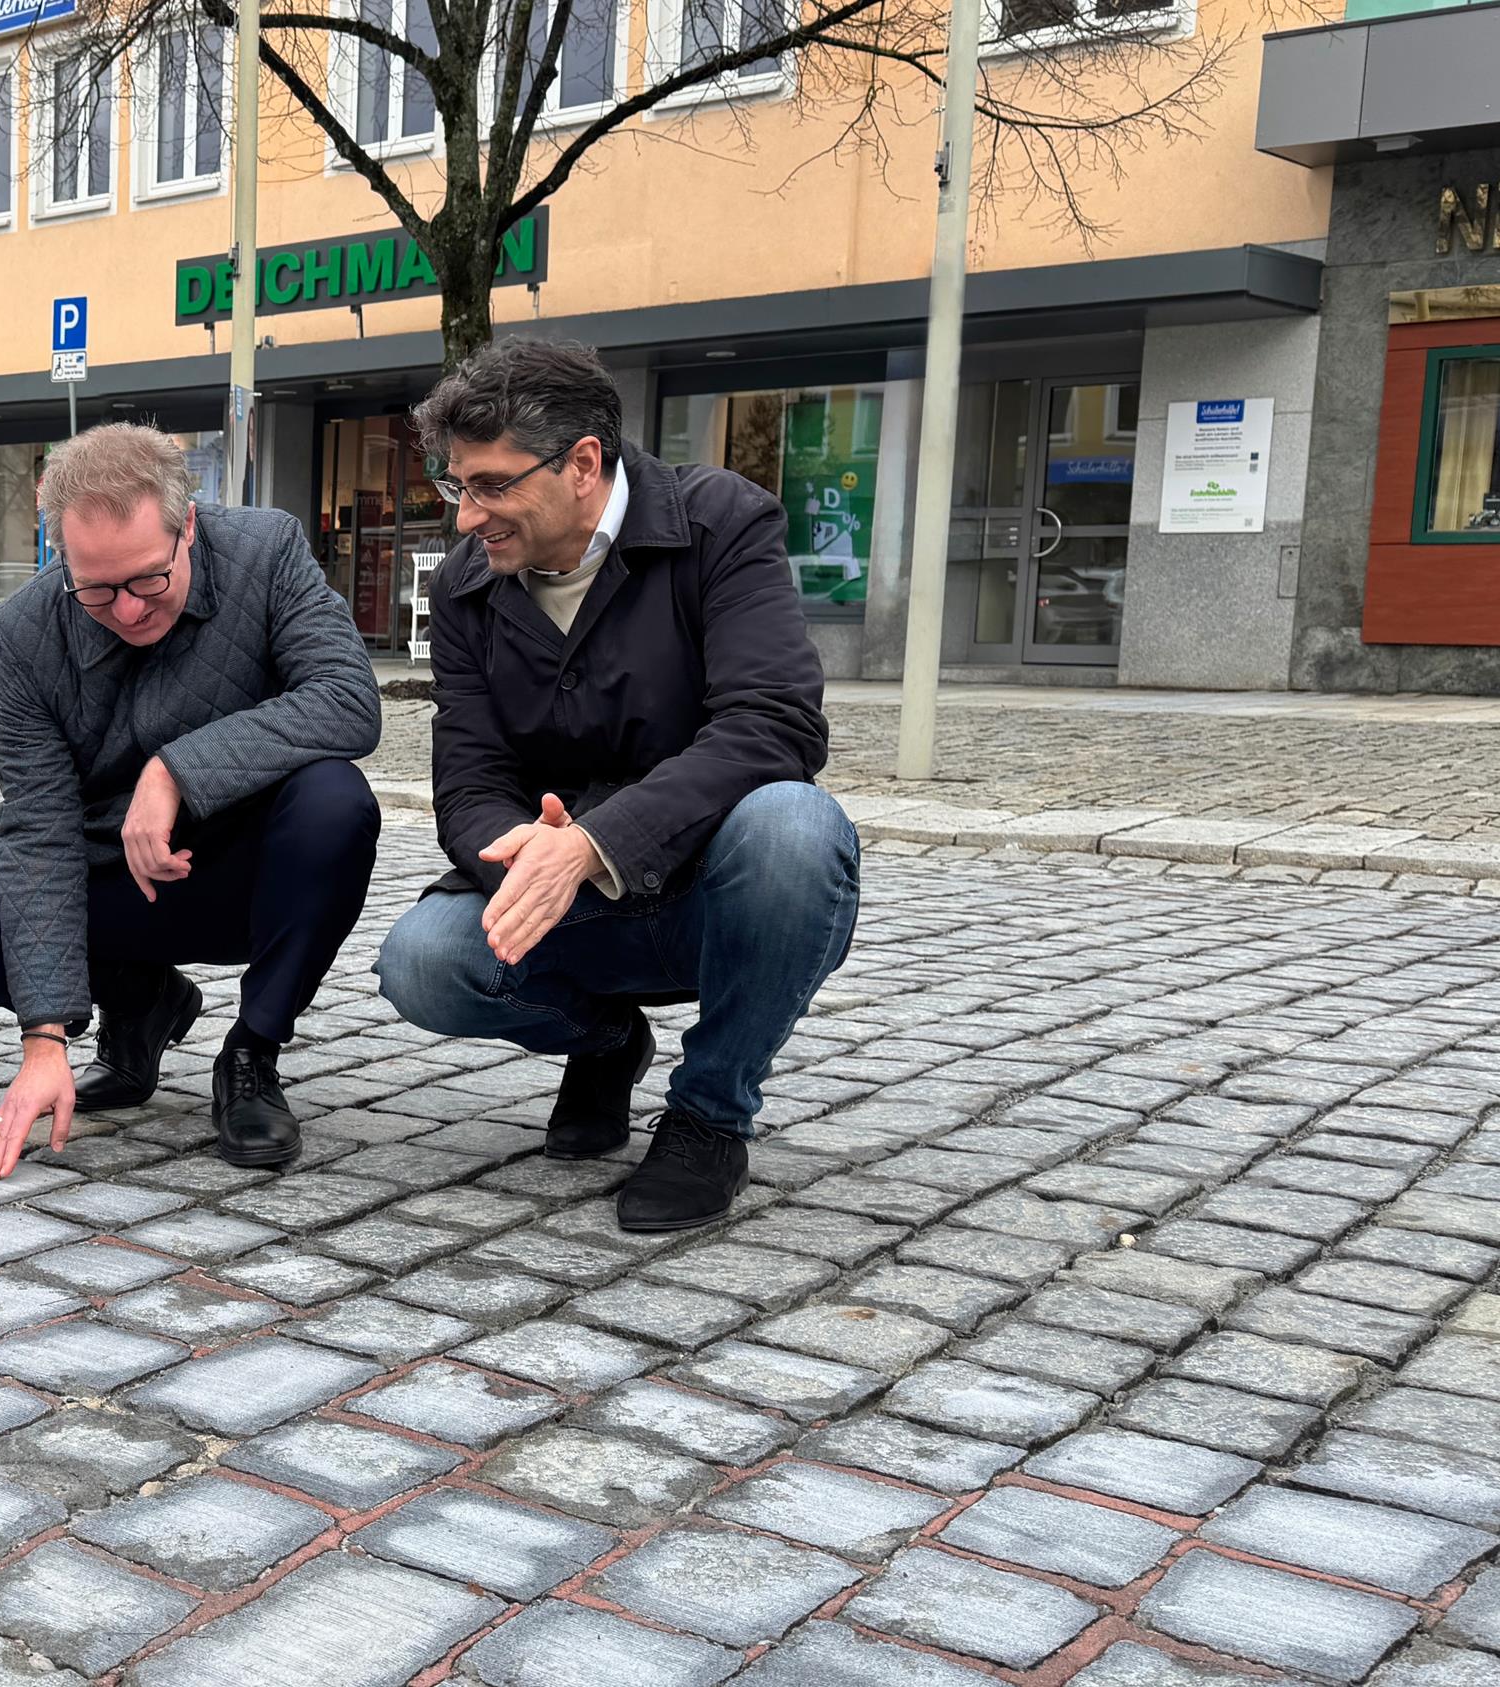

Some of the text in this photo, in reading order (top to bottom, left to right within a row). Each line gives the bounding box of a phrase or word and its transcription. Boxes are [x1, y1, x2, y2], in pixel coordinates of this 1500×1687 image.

[1436, 182, 1500, 253] N
[178, 216, 535, 316] DECHMAN
[60, 303, 79, 345] P
[823, 487, 841, 509] D
